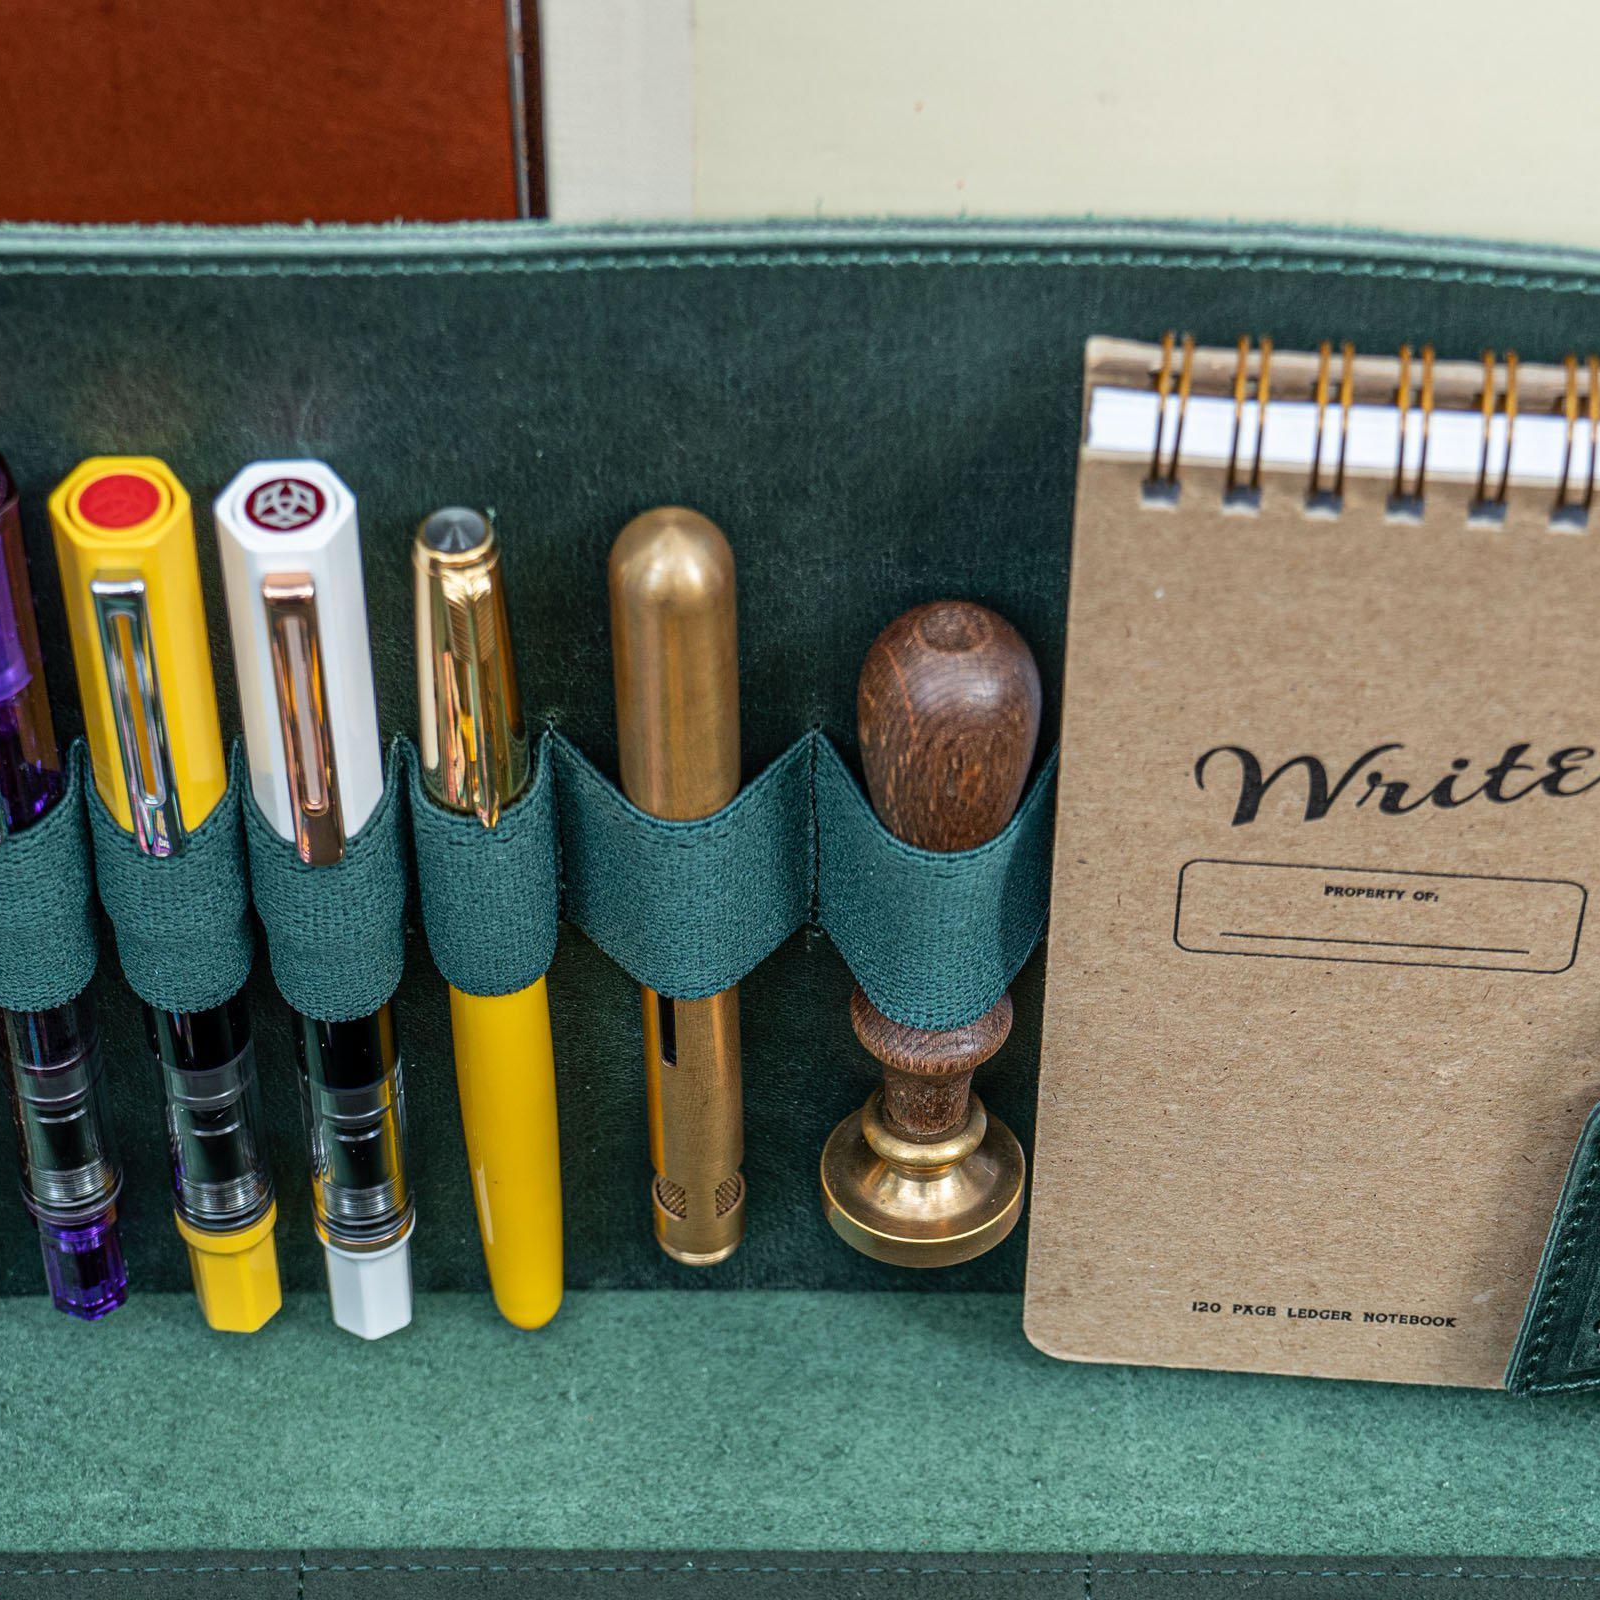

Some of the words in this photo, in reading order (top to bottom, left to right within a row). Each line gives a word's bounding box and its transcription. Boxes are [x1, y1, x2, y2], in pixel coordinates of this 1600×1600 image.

[1324, 885, 1405, 901] PROPERTY
[1413, 890, 1439, 903] OF:
[1192, 1301, 1222, 1314] 120
[1232, 1303, 1277, 1317] PAGE
[1287, 1307, 1352, 1322] LEDGER
[1363, 1312, 1457, 1328] NOTEBOOK
